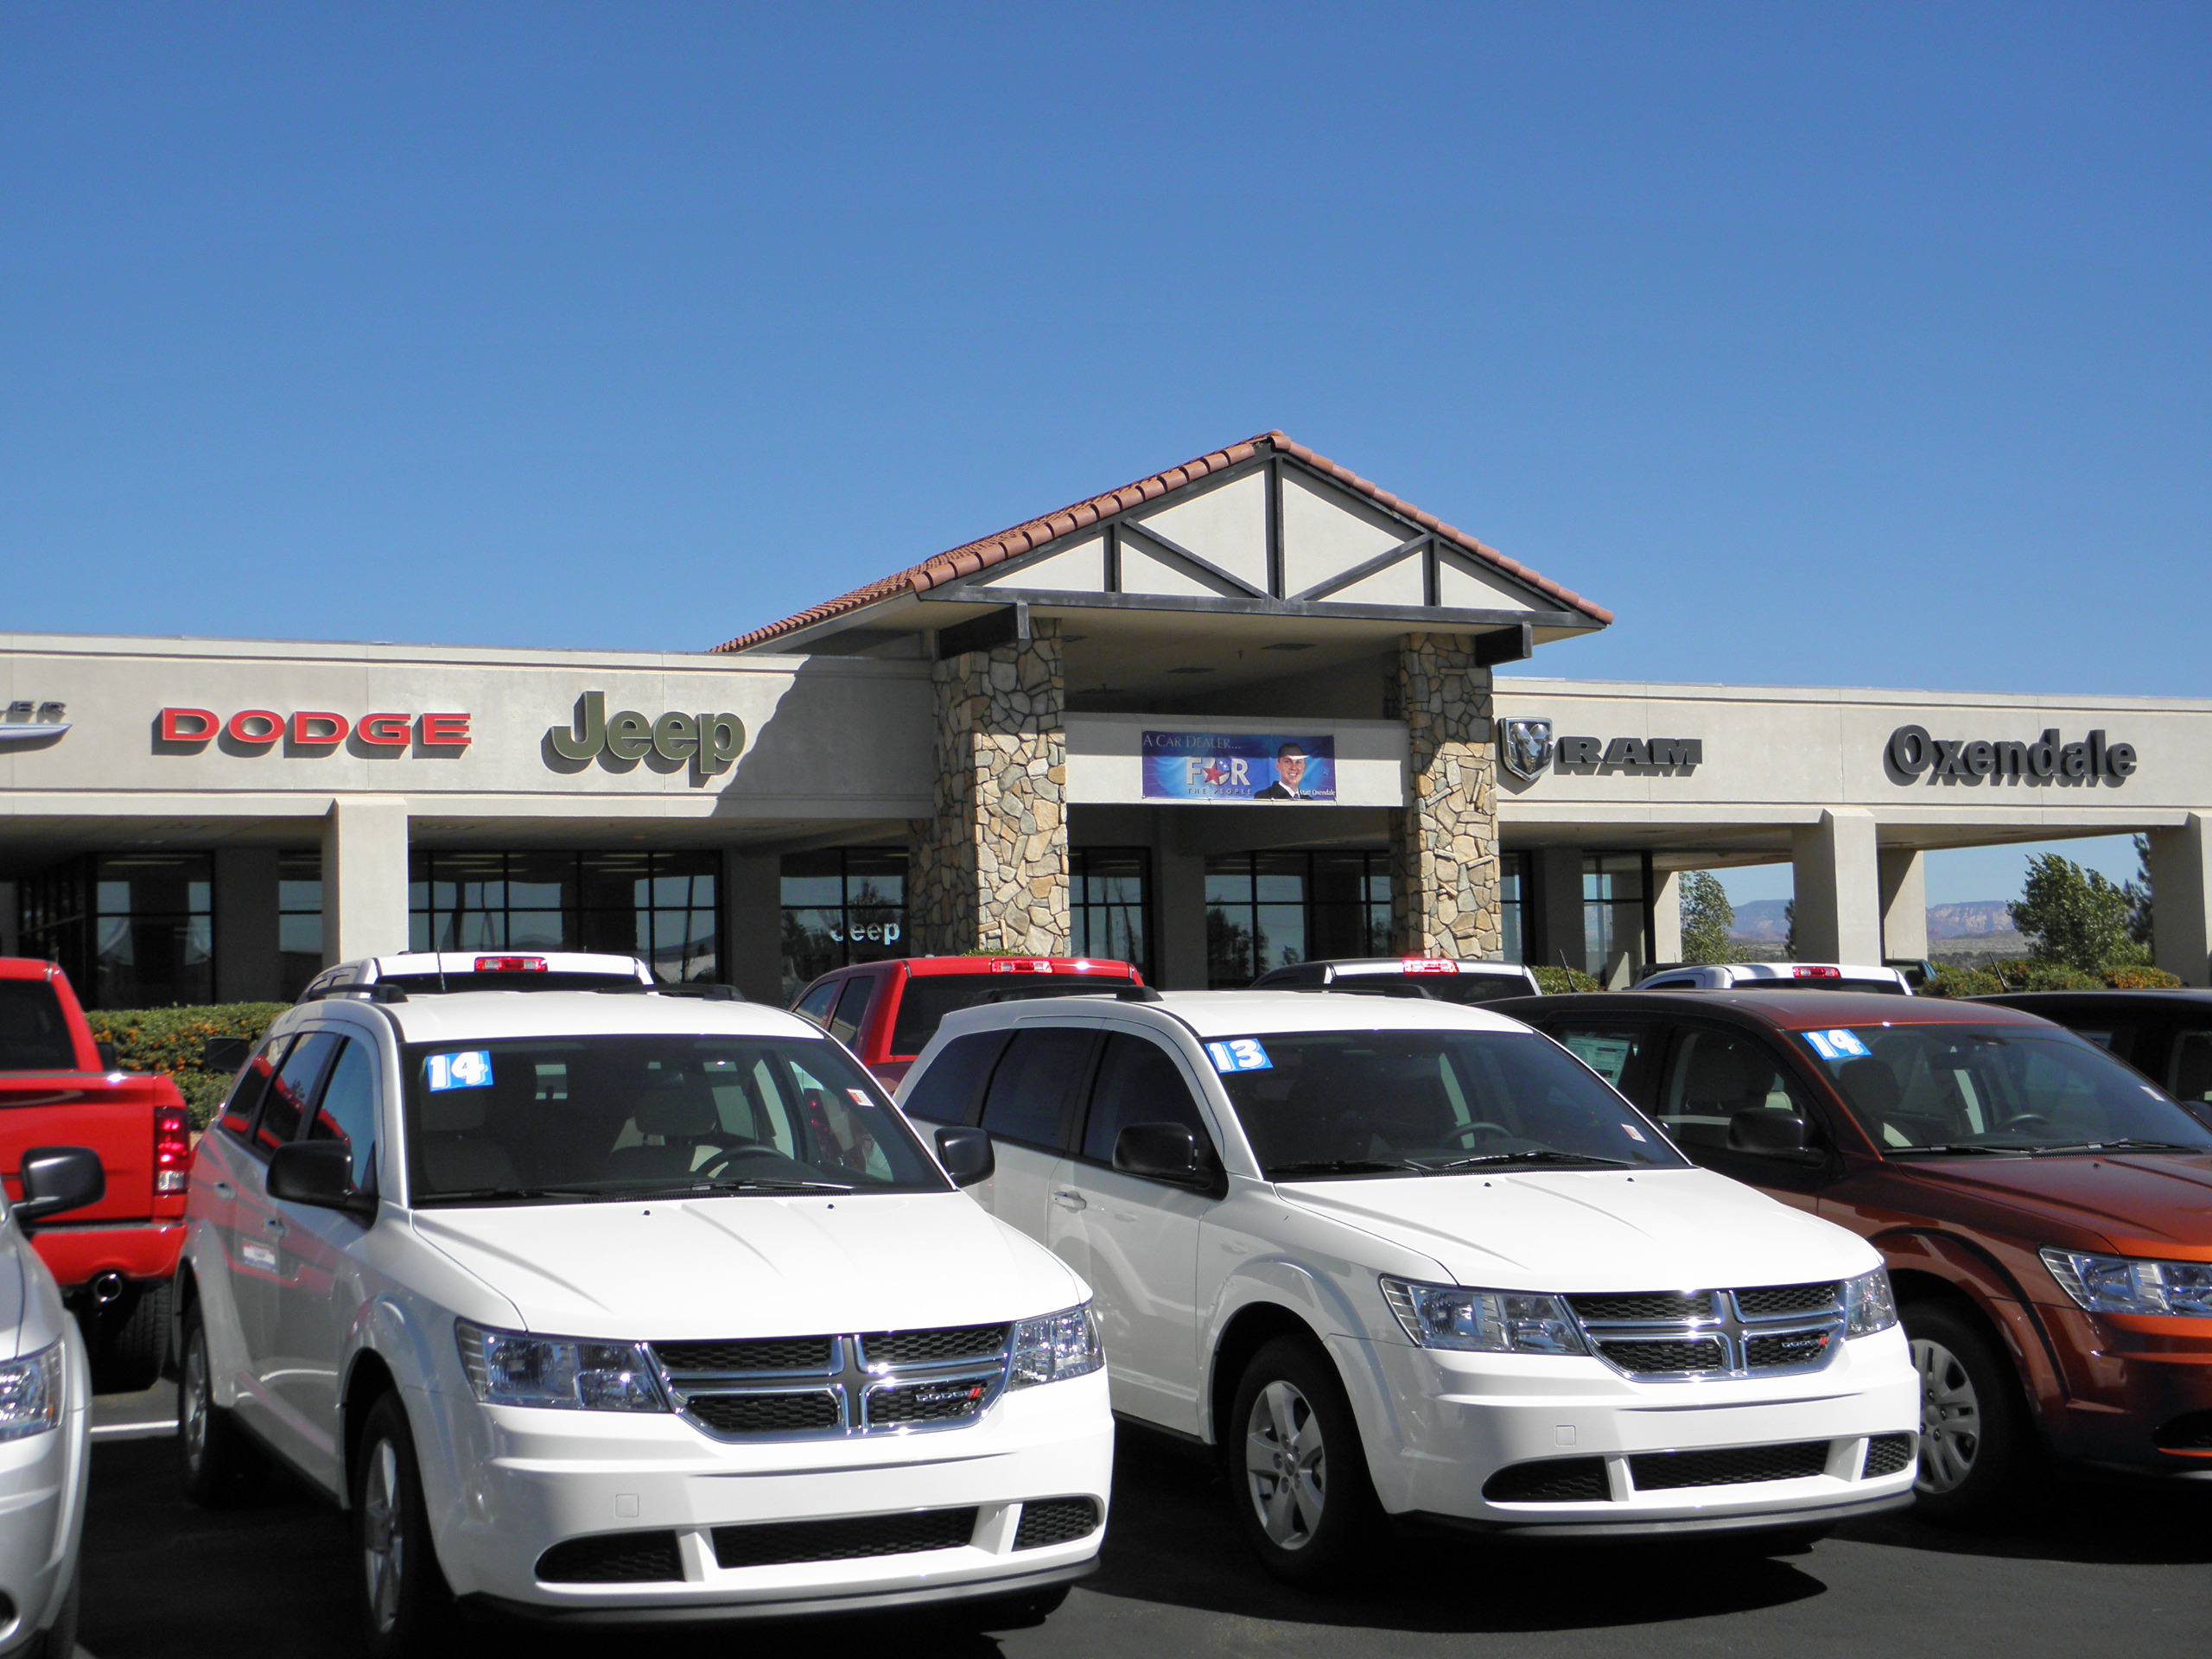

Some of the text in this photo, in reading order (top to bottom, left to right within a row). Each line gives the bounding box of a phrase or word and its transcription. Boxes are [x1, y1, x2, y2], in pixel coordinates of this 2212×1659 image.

[0, 700, 67, 716] ER
[161, 707, 473, 746] DODGE
[550, 690, 747, 774] Jeep
[1143, 734, 1154, 747] A
[1560, 736, 1703, 765] RAM
[1889, 724, 2139, 779] Oxendale
[1186, 757, 1251, 786] FOR
[1209, 1039, 1266, 1071] 13
[1807, 1029, 1865, 1058] 14
[430, 1051, 488, 1089] 14
